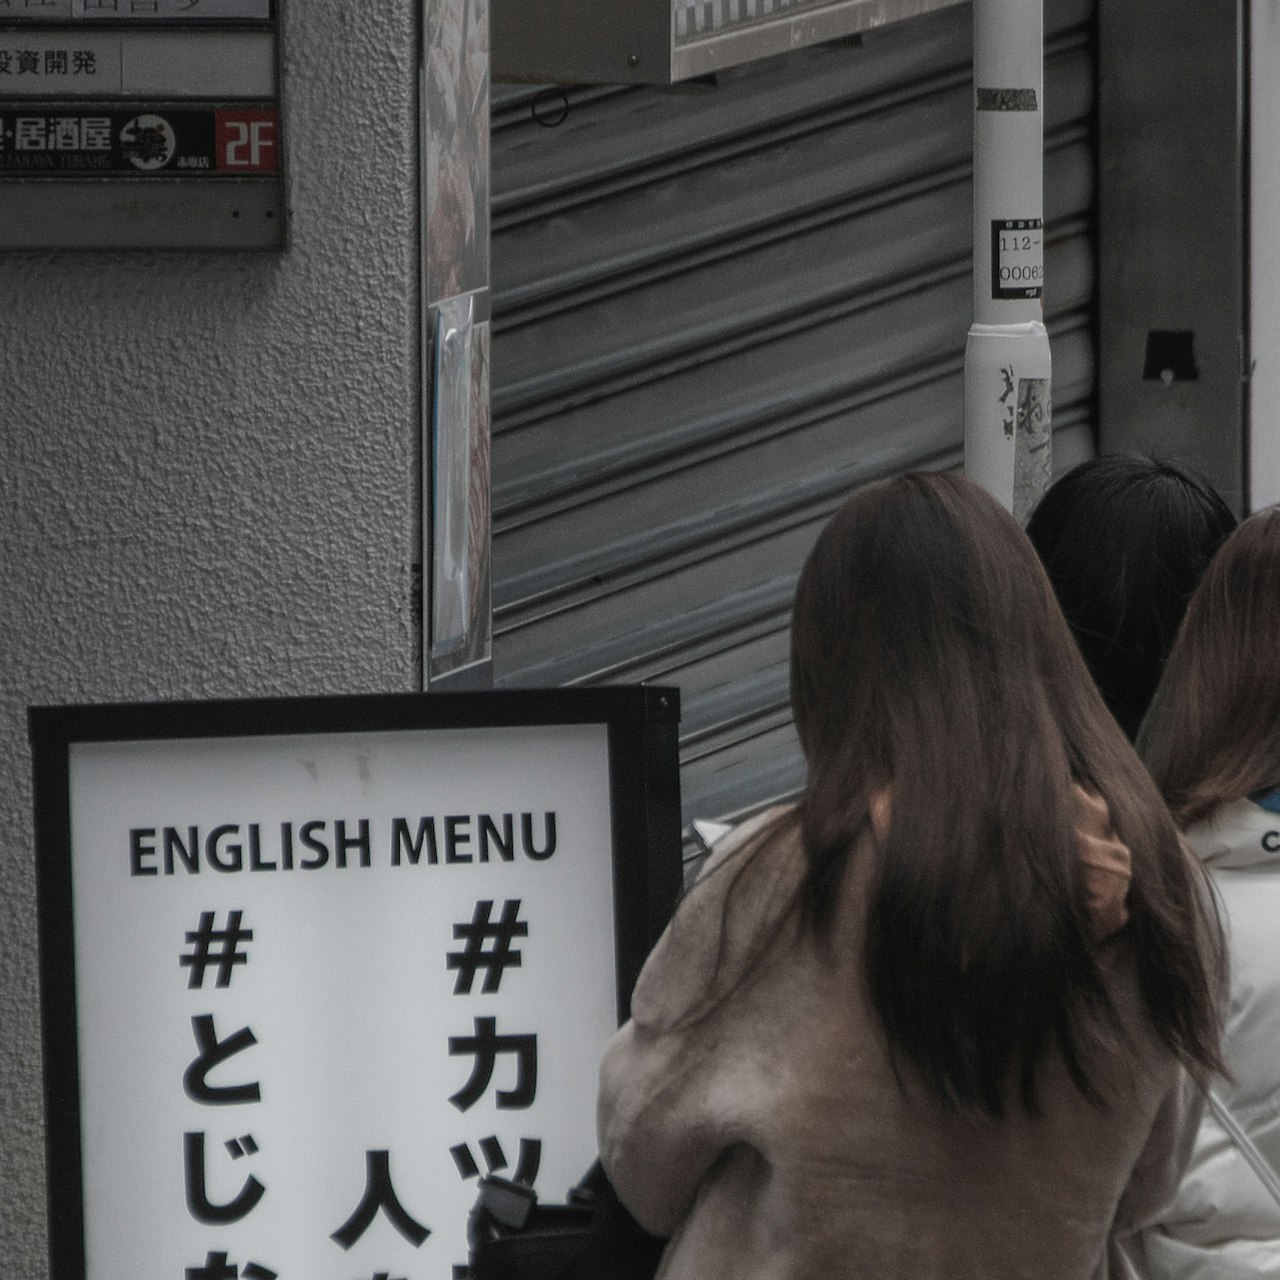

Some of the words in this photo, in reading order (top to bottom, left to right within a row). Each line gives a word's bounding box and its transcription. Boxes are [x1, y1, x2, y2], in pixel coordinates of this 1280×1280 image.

[224, 121, 274, 166] 2F
[129, 818, 372, 876] ENGLISH
[391, 811, 557, 866] MENU
